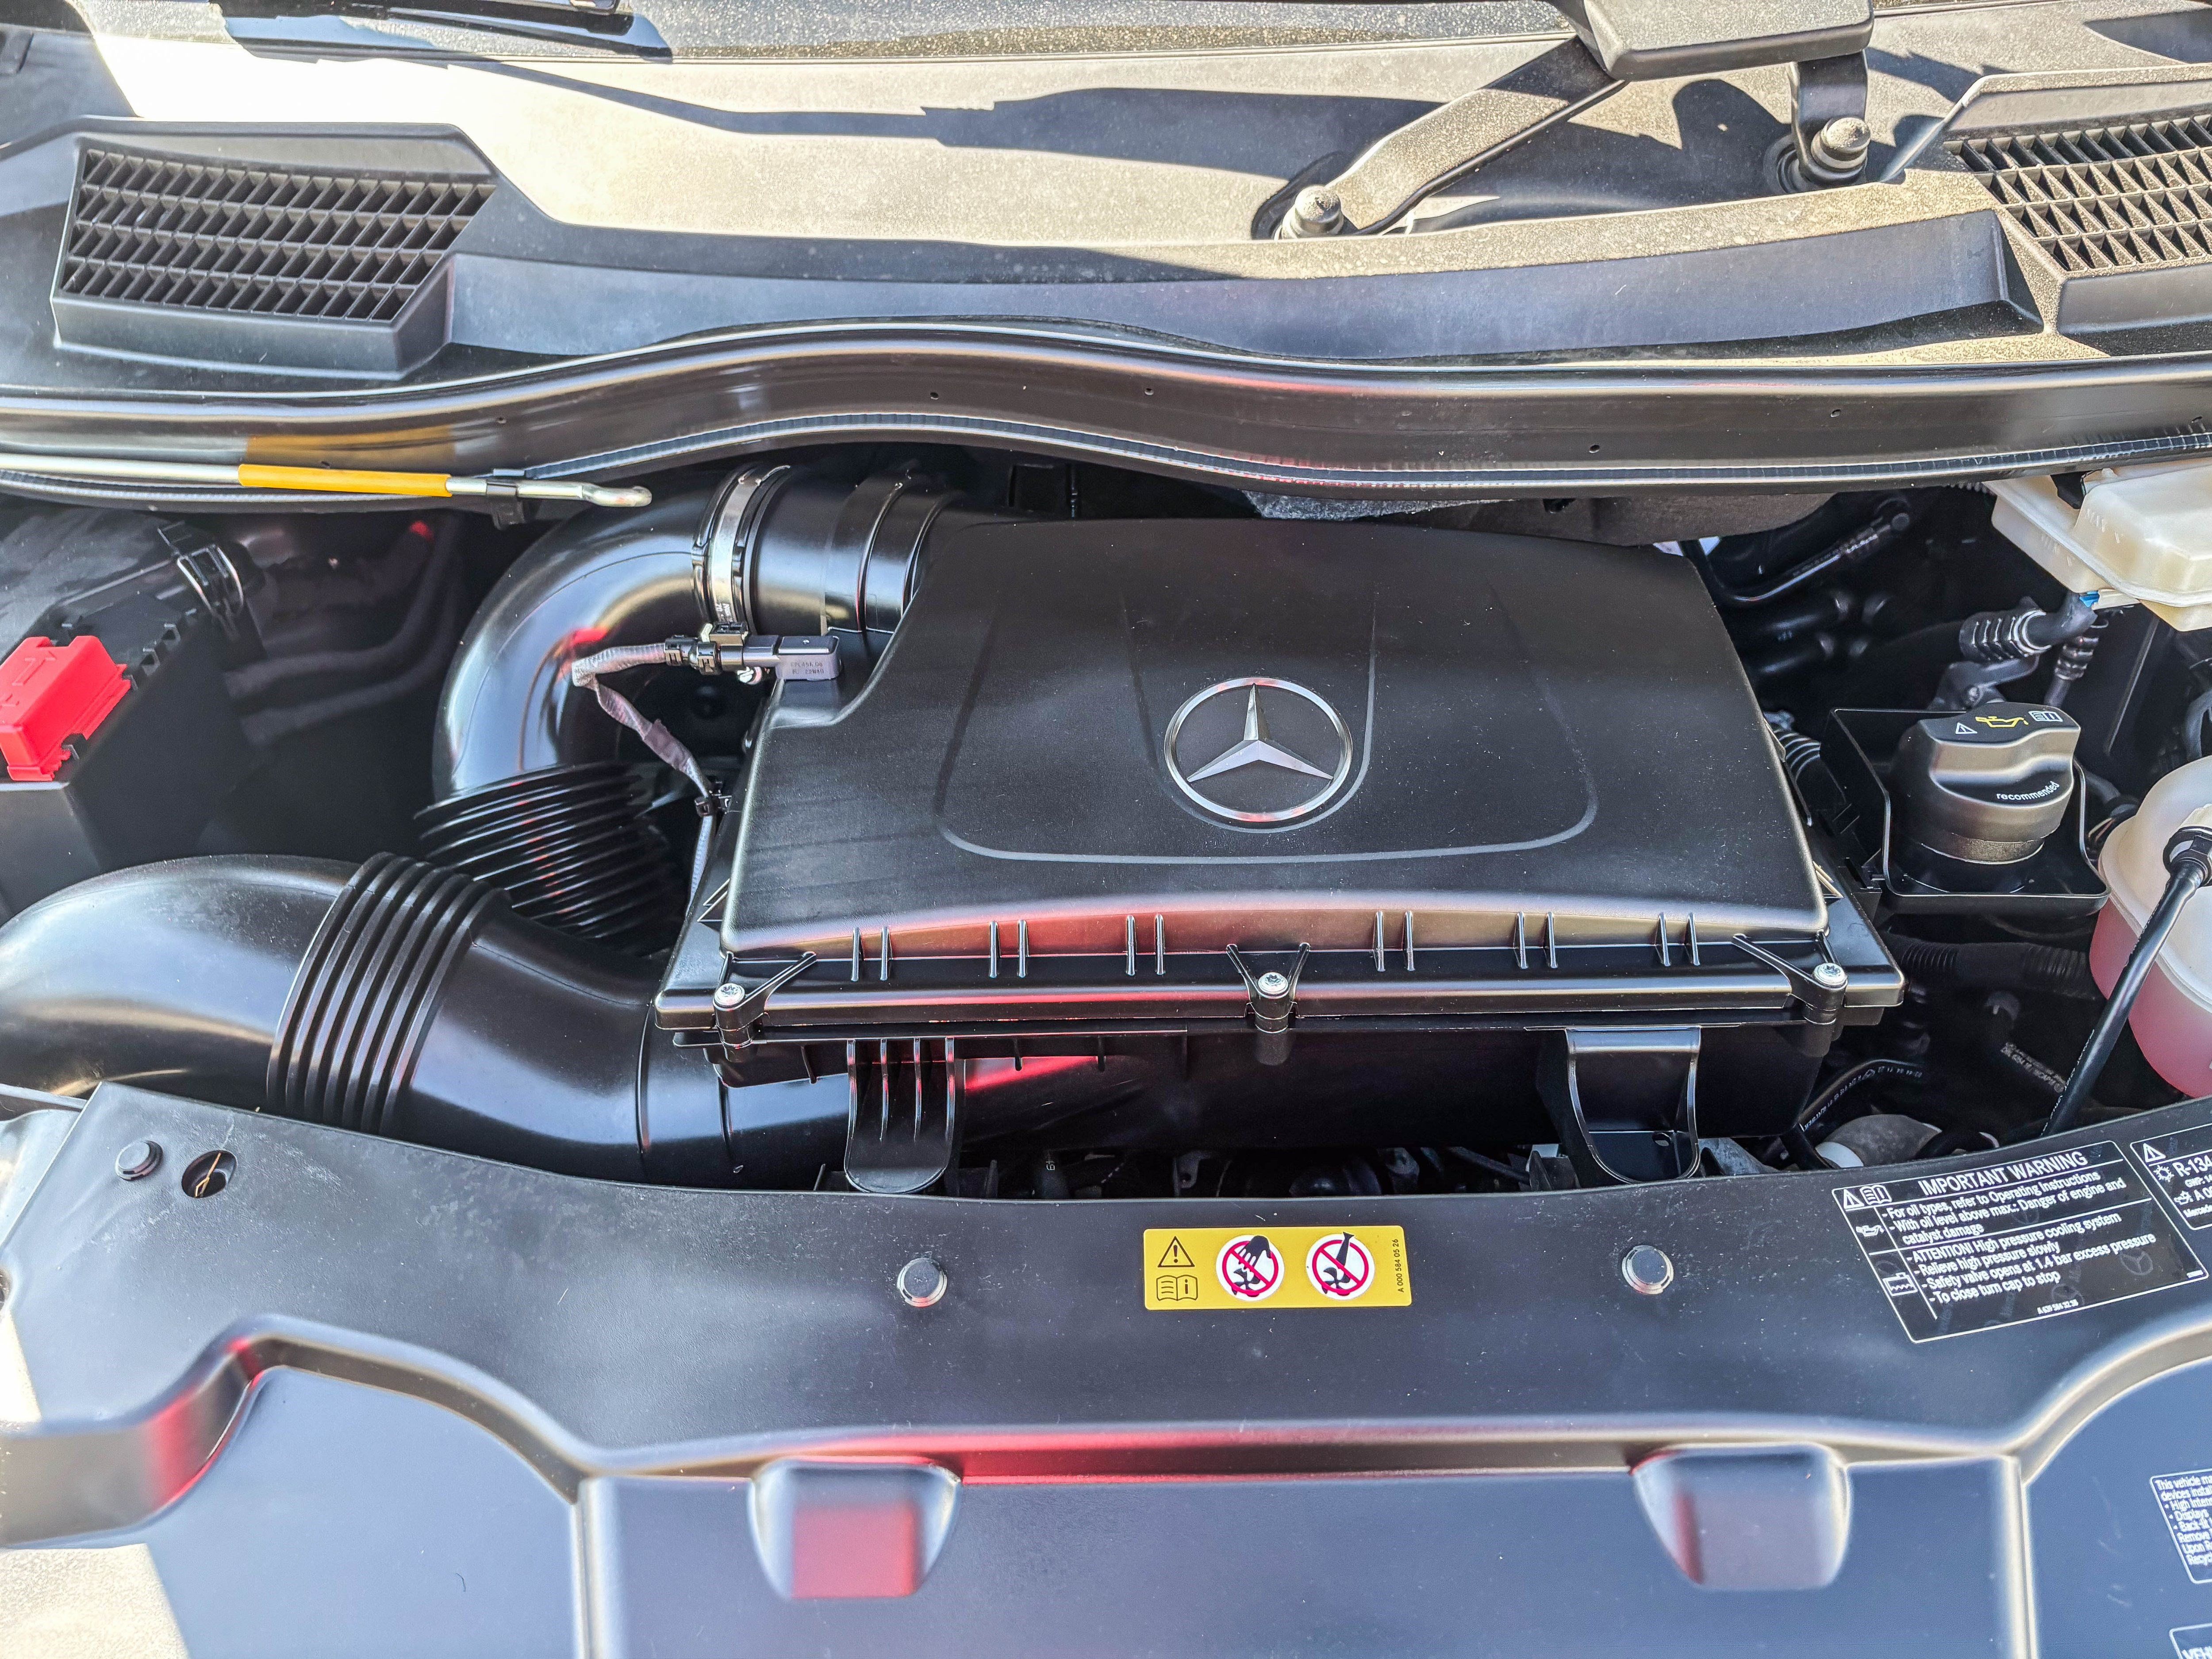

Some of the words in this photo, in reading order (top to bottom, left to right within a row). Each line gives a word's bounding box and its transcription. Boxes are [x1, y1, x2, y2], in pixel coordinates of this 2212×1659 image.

[1996, 780, 2060, 801] recommended
[1918, 1167, 2009, 1196] IMPORTANT
[2006, 1151, 2089, 1180] WARNING
[1907, 1204, 1921, 1216] oil
[1919, 1201, 1953, 1216] types,
[1951, 1196, 1976, 1209] refer
[1976, 1194, 1989, 1205] to
[1989, 1183, 2042, 1203] Operating
[2038, 1171, 2101, 1192] Instructions
[1920, 1215, 1934, 1228] oil
[1932, 1212, 1959, 1226] level
[1958, 1208, 1990, 1221] above
[2017, 1194, 2057, 1209] Danger
[2058, 1190, 2070, 1202] of
[2070, 1184, 2105, 1199] engine
[2105, 1177, 2127, 1191] and
[2194, 1189, 2205, 1202] A
[1392, 1239, 1399, 1247] 26
[1902, 1229, 1944, 1245] catalyst
[1943, 1224, 1984, 1238] damage
[1972, 1238, 2000, 1253] High
[1998, 1231, 2045, 1250] pressure
[2045, 1221, 2085, 1238] cooling
[2082, 1213, 2122, 1231] system
[1393, 1248, 1401, 1258] 05
[1956, 1256, 1982, 1271] high
[1981, 1248, 2028, 1268] pressure
[2027, 1240, 2060, 1257] slowly
[1961, 1270, 1990, 1284] valve
[1989, 1264, 2023, 1281] opens
[2022, 1260, 2036, 1272] at
[2035, 1256, 2054, 1270] 1.4
[2052, 1252, 2073, 1266] bar
[2073, 1244, 2111, 1261] excess
[2109, 1233, 2157, 1255] pressure
[1950, 1287, 1980, 1302] close
[1978, 1283, 2003, 1296] turn
[2002, 1279, 2023, 1293] cap
[2021, 1274, 2036, 1287] to
[2035, 1271, 2061, 1285] stop
[2155, 1479, 2174, 1490] This
[2173, 1475, 2201, 1488] vehicle
[2161, 1488, 2191, 1502] devices
